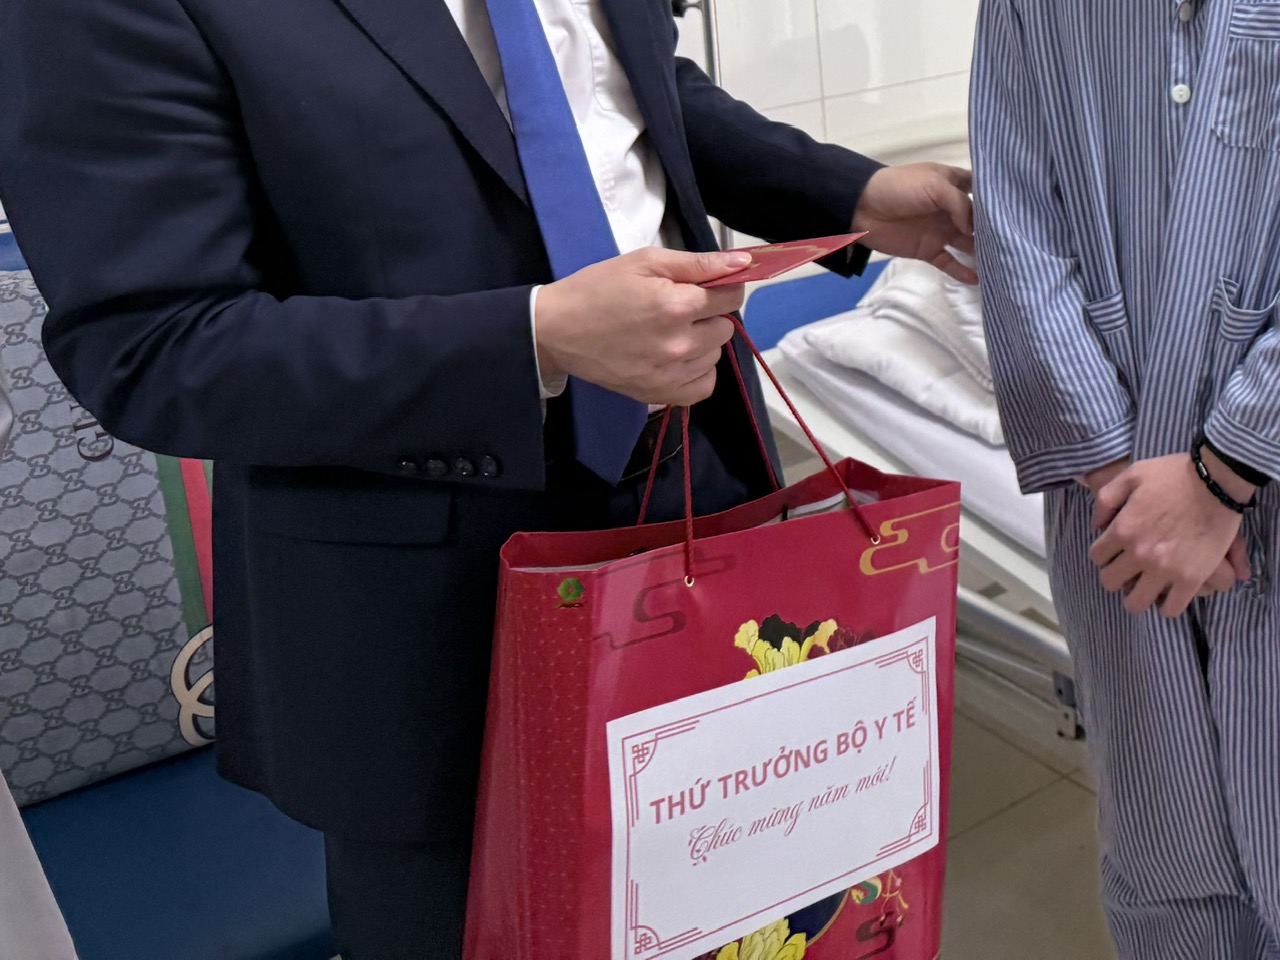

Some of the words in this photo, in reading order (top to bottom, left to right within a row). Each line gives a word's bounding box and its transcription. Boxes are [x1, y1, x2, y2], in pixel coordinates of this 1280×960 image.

[650, 777, 711, 825] THỨ
[717, 739, 829, 800] TRƯỞNG
[836, 720, 867, 756] BỘ
[874, 716, 887, 740] Y
[892, 695, 917, 733] TẾ
[688, 817, 743, 866] Chúc
[747, 800, 804, 837] mừng
[807, 783, 849, 813] năm
[854, 754, 897, 794] mới!
